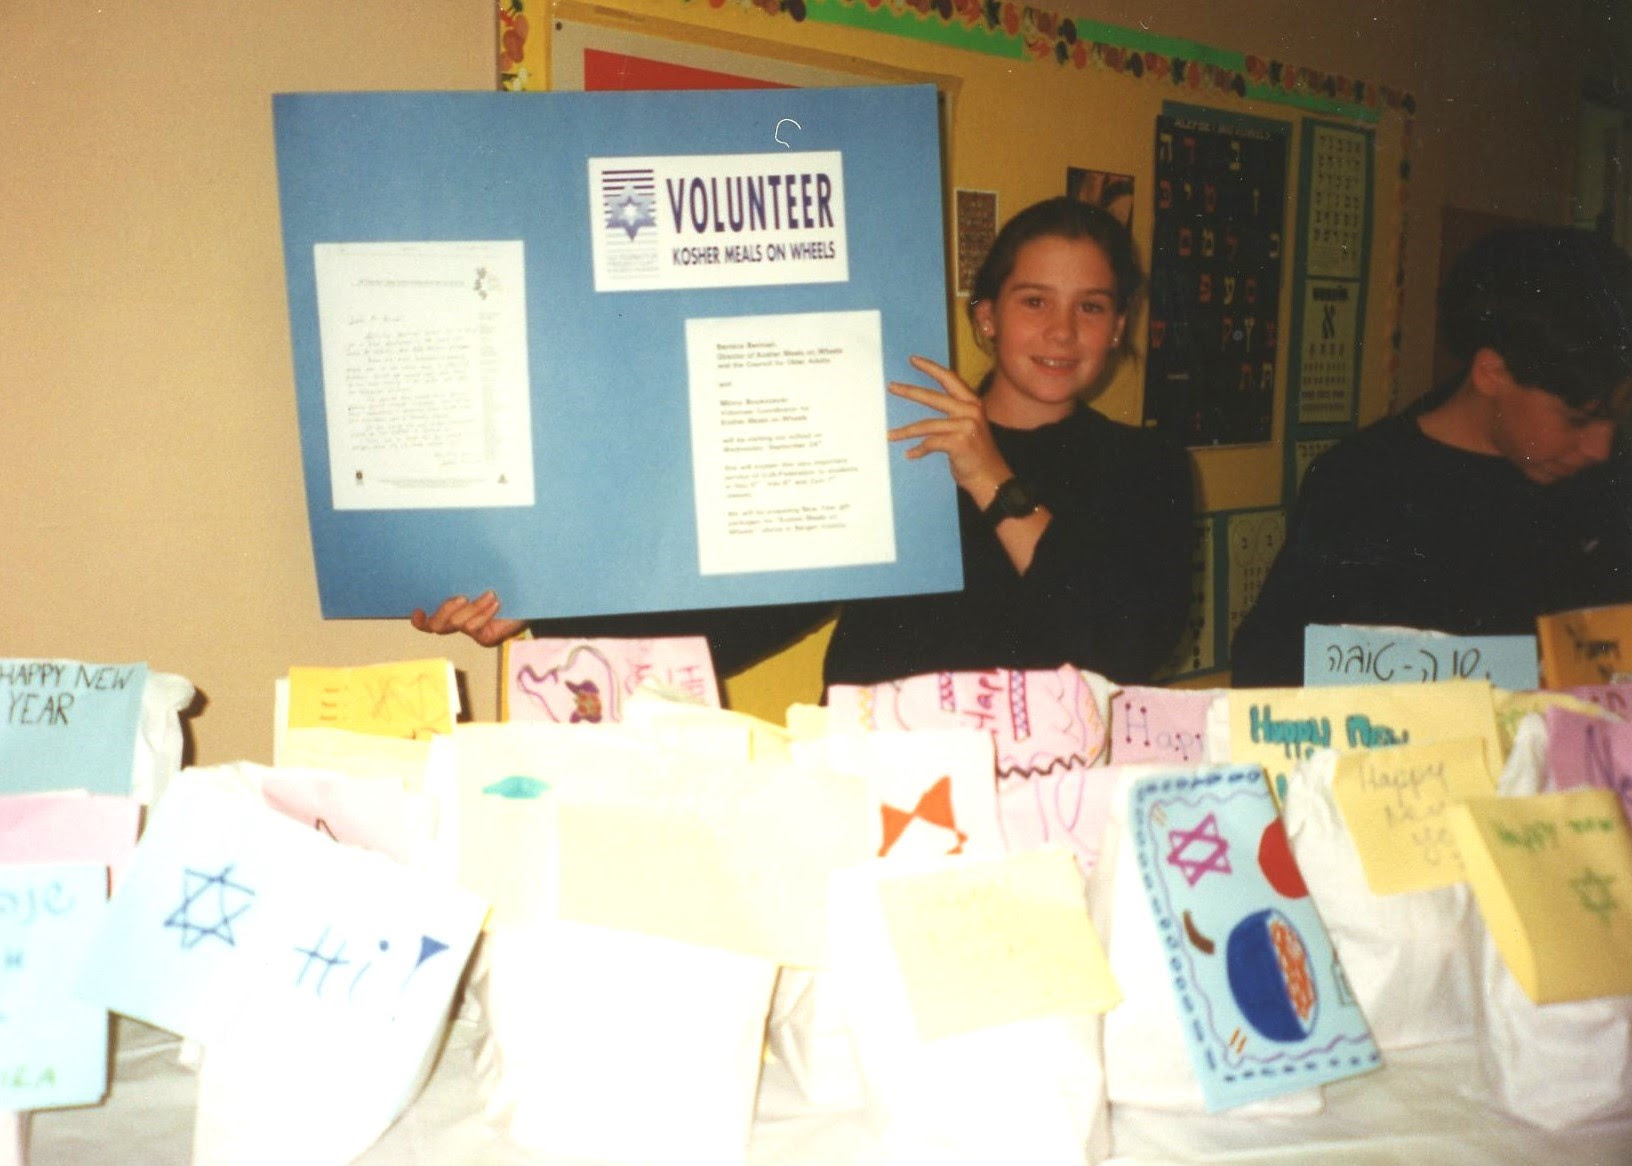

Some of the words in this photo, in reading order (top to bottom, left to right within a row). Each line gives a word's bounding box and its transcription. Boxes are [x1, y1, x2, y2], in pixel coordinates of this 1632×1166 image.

[667, 172, 835, 234] VOLUNTEER
[672, 245, 721, 266] KOSHER
[724, 244, 762, 264] MEALS
[767, 243, 786, 261] ON
[791, 241, 835, 260] WHEELS
[757, 351, 780, 359] Kosher
[784, 349, 804, 357] Meals
[818, 347, 843, 355] Wheels
[782, 414, 807, 422] Wheels
[0, 662, 66, 688] HAPPY
[75, 663, 134, 691] NEW
[8, 691, 75, 726] YEAR
[1124, 701, 1204, 761] Hap
[1249, 703, 1332, 760] Happy
[1358, 761, 1450, 809] Happy
